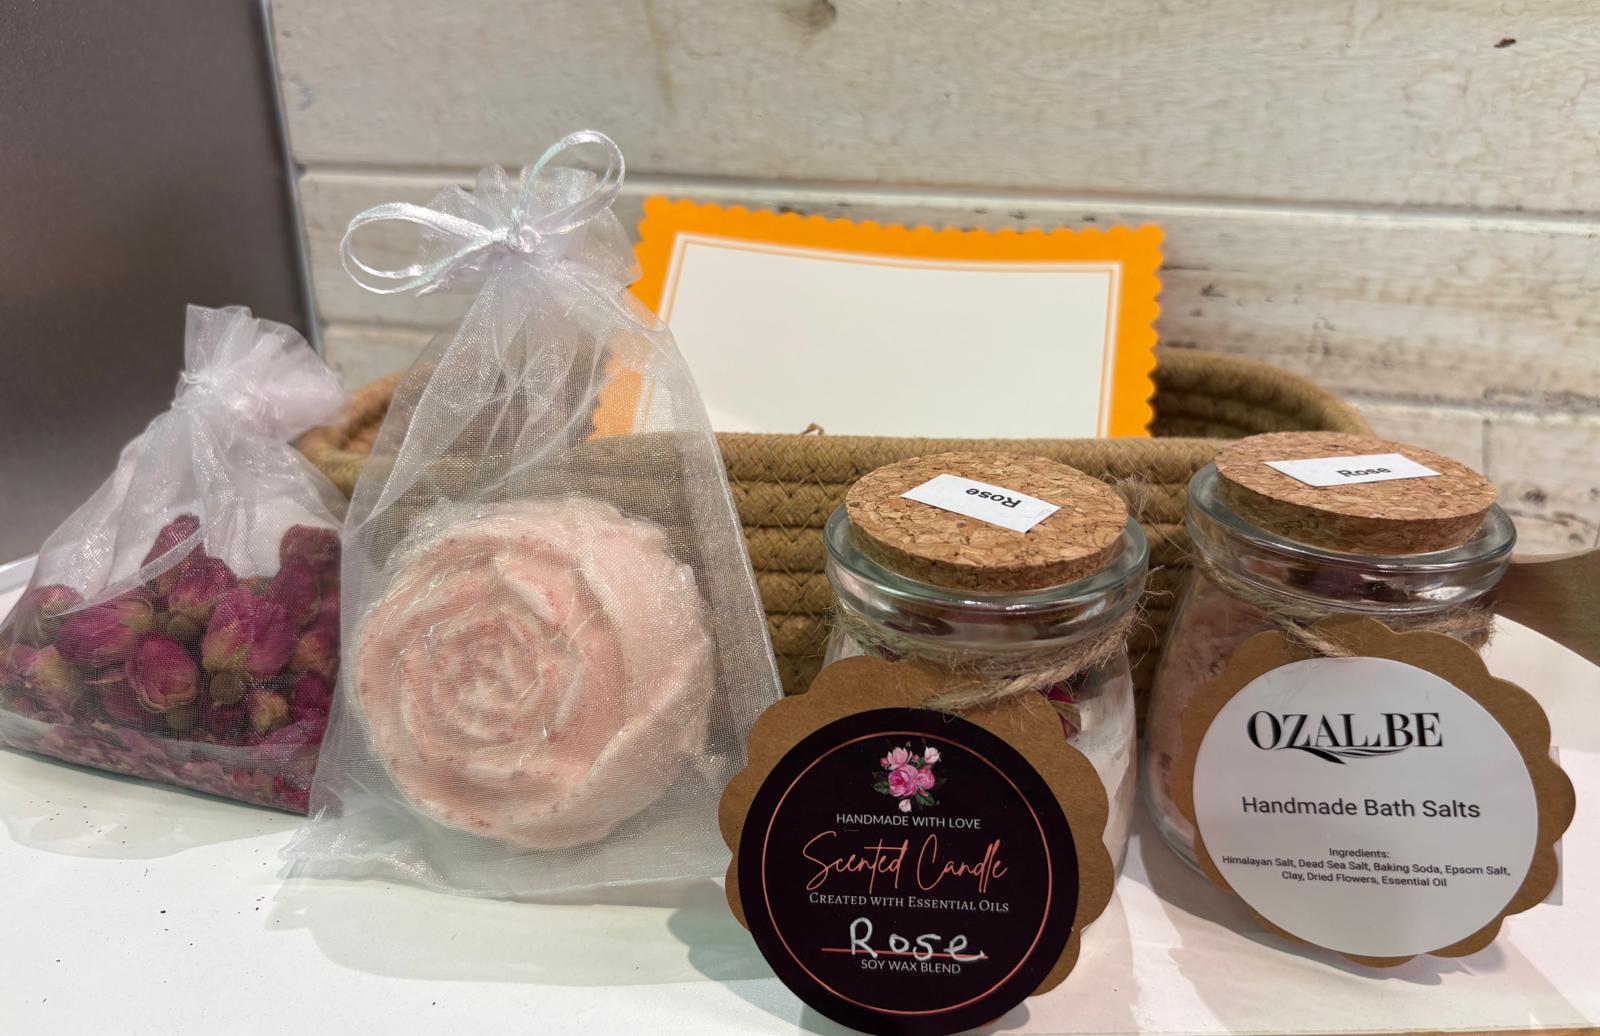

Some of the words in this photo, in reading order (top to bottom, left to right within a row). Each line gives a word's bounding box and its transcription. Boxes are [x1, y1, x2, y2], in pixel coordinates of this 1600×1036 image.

[1336, 467, 1392, 478] Rose
[966, 488, 1021, 508] Rose
[1242, 797, 1357, 815] Handmade
[1364, 798, 1415, 817] Bath
[1422, 800, 1481, 818] Salts
[836, 813, 909, 826] HANDMADE
[912, 815, 946, 828] WITH
[949, 817, 981, 829] LOVE
[802, 830, 909, 894] Scented
[917, 833, 1008, 893] Candle
[1328, 848, 1390, 859] Ingredients:
[1222, 855, 1273, 867] Himalayan
[1275, 858, 1297, 868] Salt,
[1298, 859, 1324, 868] Dead
[1327, 860, 1346, 869] Sea
[1349, 861, 1371, 871] Salt,
[1373, 862, 1409, 874] Baking
[1412, 864, 1442, 874] Soda,
[1445, 865, 1483, 876] Epsom
[1486, 866, 1510, 876] Salt,
[1281, 870, 1304, 881] Clay,
[1307, 871, 1333, 882] Dried
[1336, 873, 1379, 885] Flowers,
[1382, 875, 1430, 886] Essential
[1432, 877, 1447, 887] Oil
[871, 896, 904, 907] WITH
[850, 917, 986, 961] Rose
[861, 959, 885, 970] SOY
[888, 961, 918, 973] WAX
[920, 962, 961, 974] BLEND
